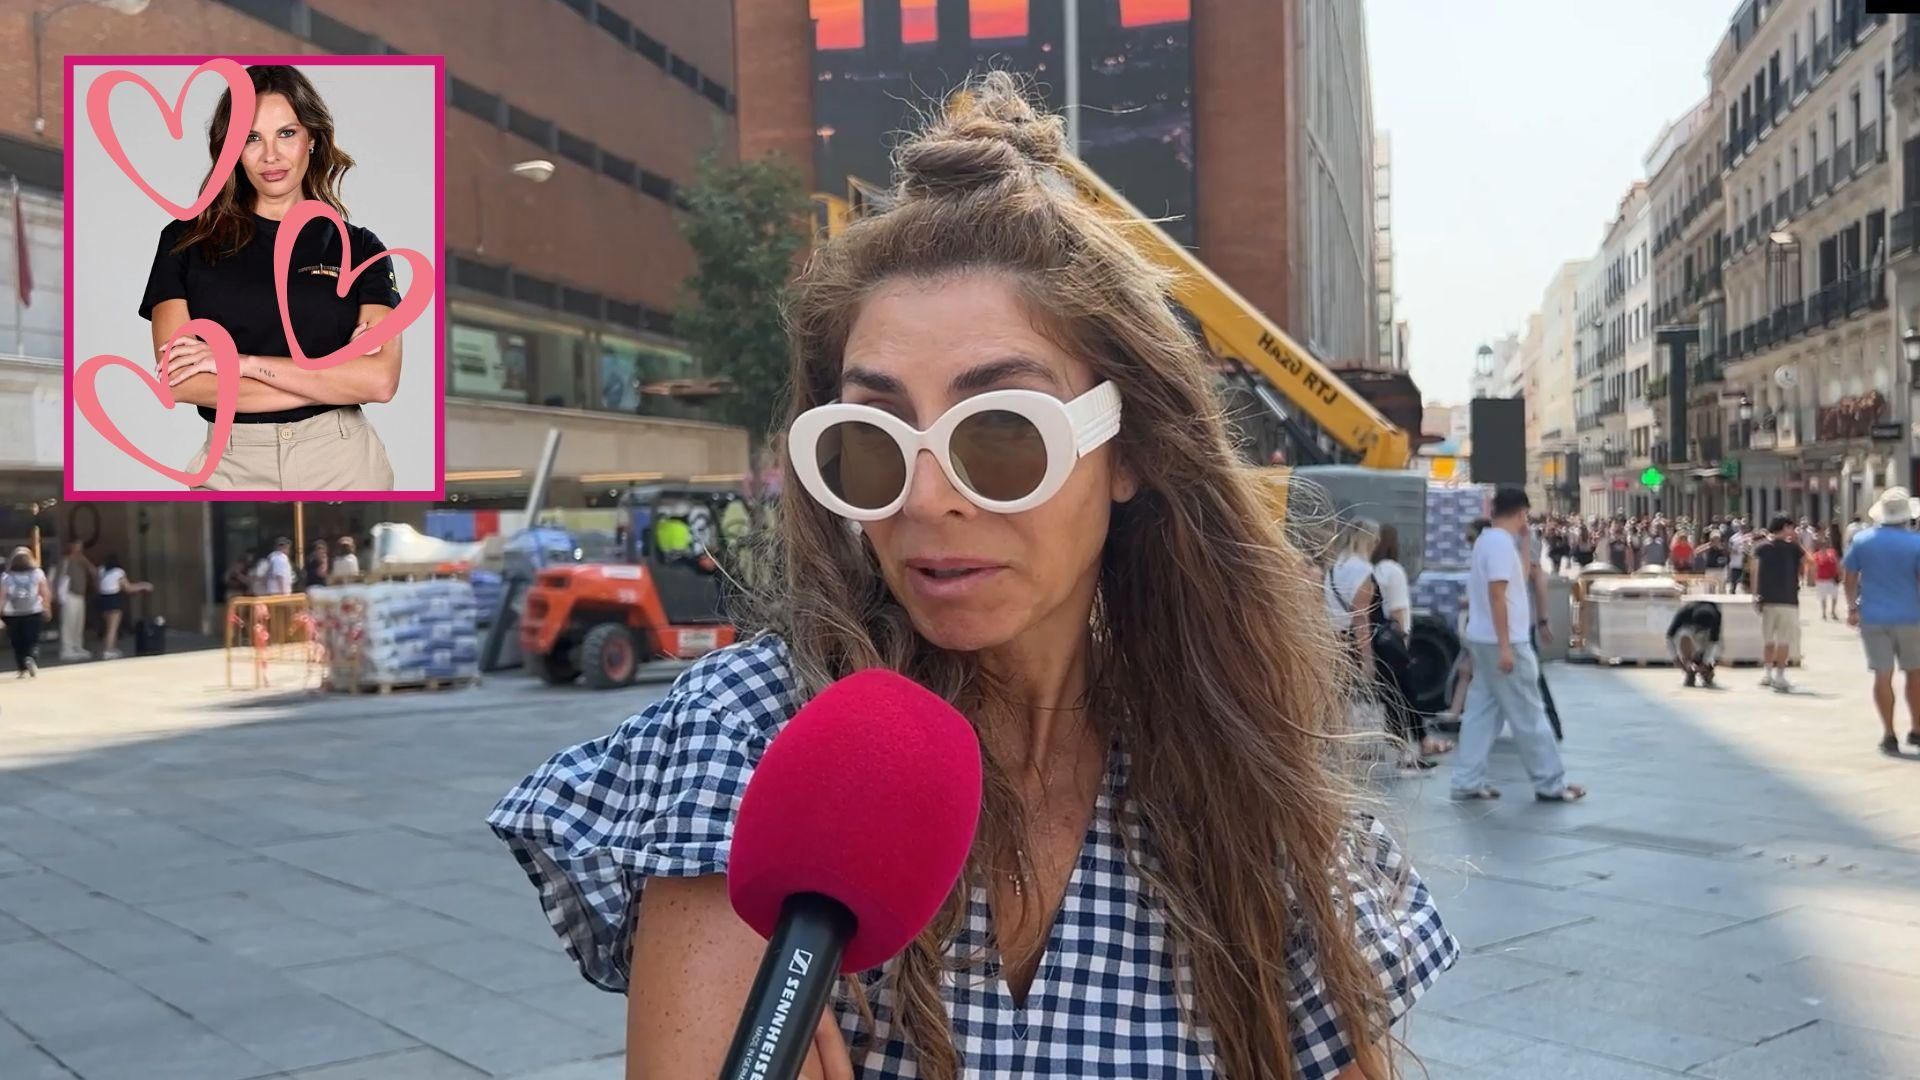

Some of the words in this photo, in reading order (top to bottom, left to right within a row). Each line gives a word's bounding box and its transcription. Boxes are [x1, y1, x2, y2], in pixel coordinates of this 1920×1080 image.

[1257, 332, 1303, 376] HA20
[1302, 371, 1339, 405] RTJ
[749, 1025, 764, 1048] MADE
